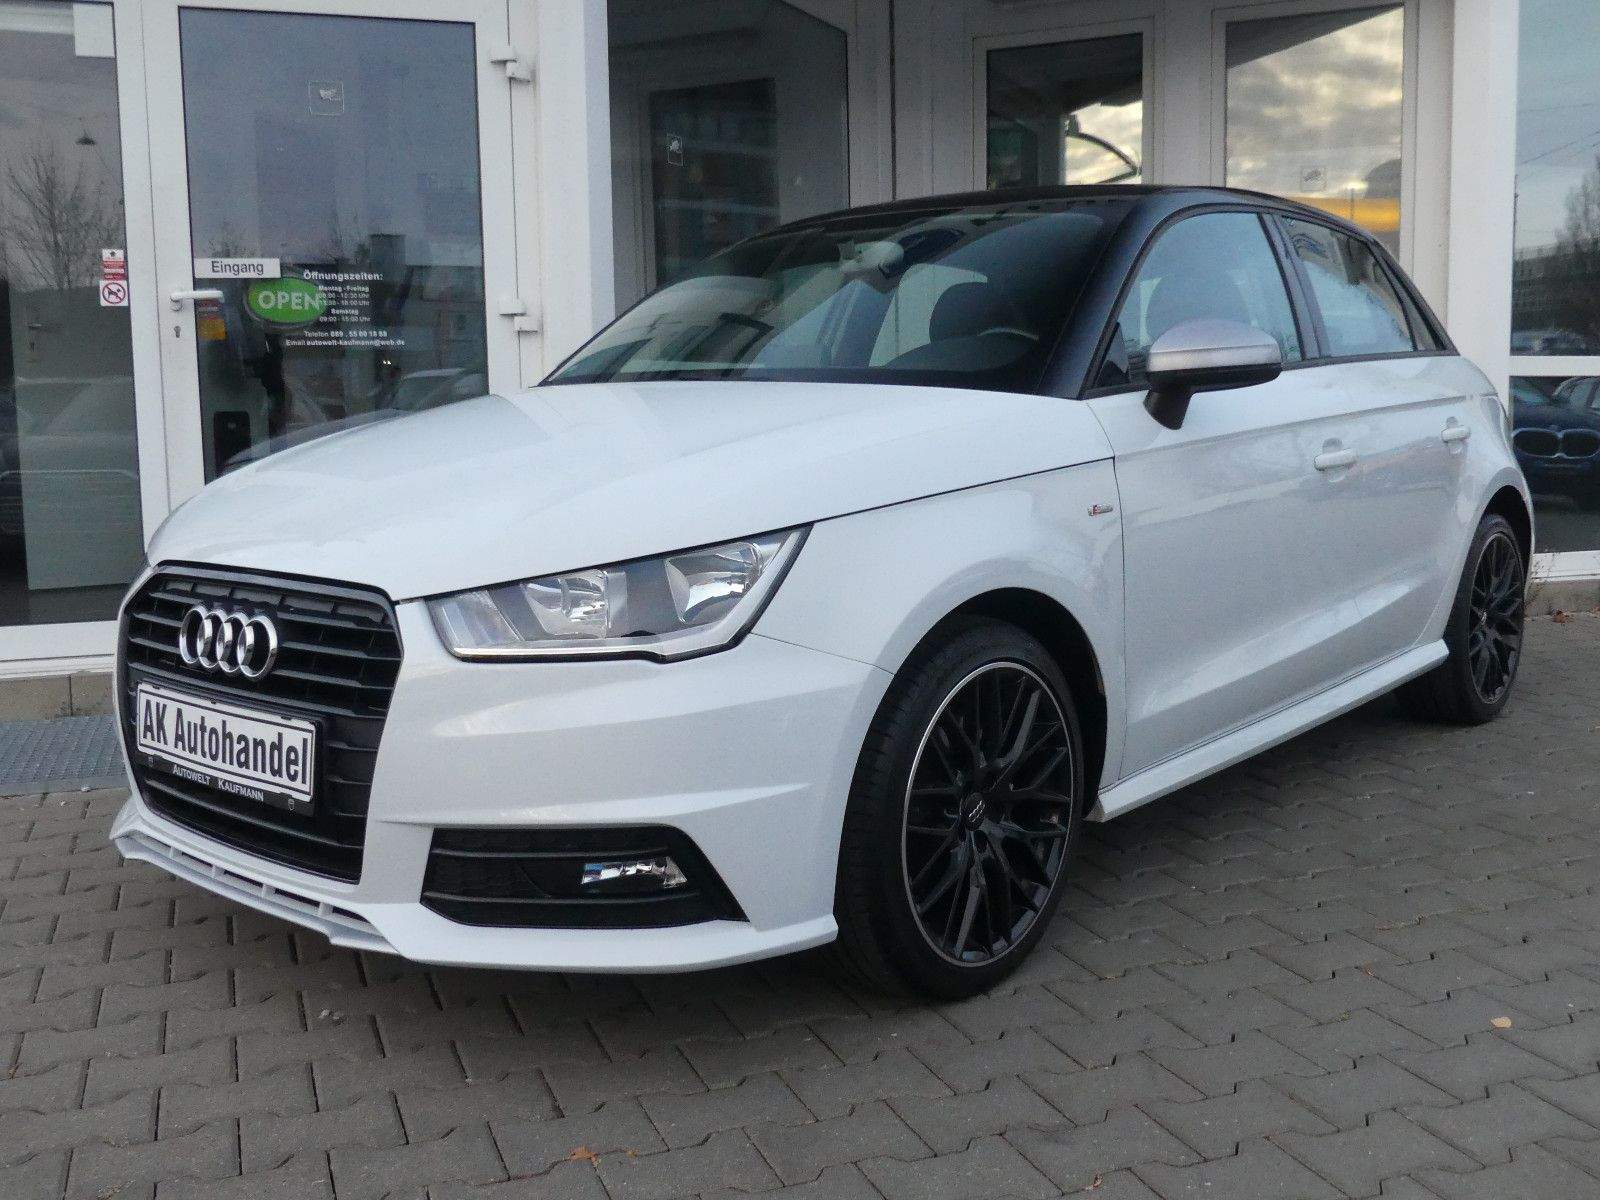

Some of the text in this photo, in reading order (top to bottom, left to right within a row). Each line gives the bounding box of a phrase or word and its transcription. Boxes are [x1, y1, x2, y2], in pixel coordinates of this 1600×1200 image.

[210, 260, 265, 275] Eingang
[303, 269, 384, 281] Öffnungszeiten:
[257, 290, 321, 311] OPEN
[142, 699, 309, 785] AK Autohandel
[172, 764, 264, 802] AUTOWELT KAUFMANN
